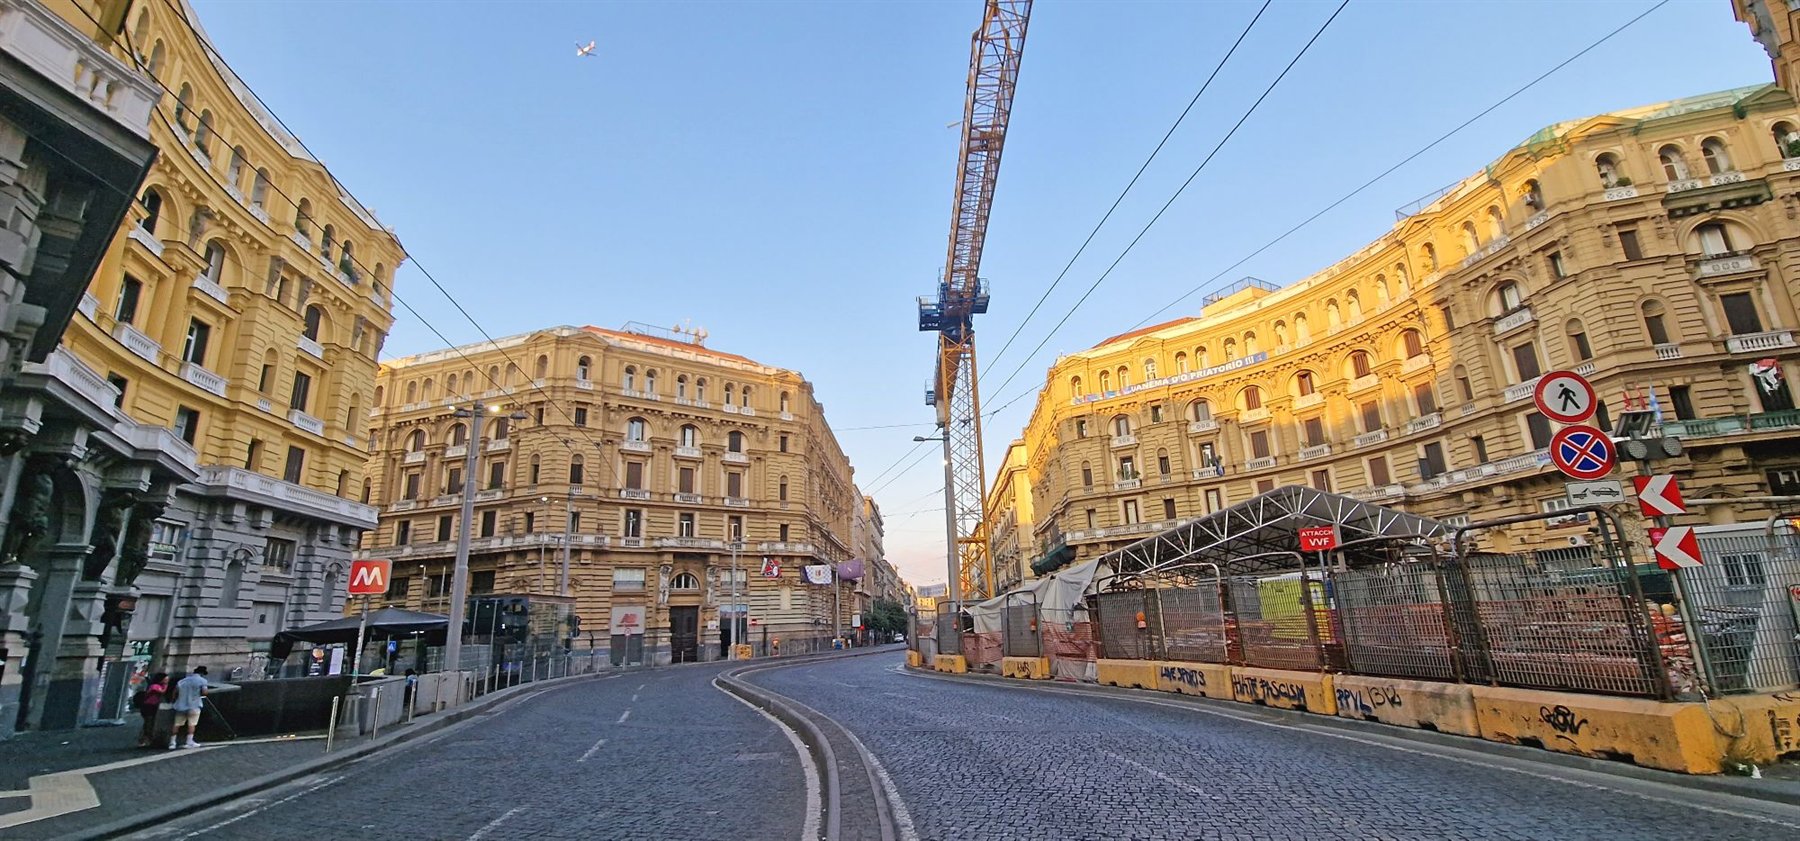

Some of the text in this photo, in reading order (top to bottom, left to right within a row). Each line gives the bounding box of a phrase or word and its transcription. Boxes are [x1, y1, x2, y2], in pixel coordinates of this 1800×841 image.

[1190, 360, 1243, 380] PRIATORIO
[1301, 529, 1334, 537] ATTACCH
[1309, 537, 1330, 546] VVF
[352, 566, 384, 586] M
[1259, 678, 1307, 702] FASCISM
